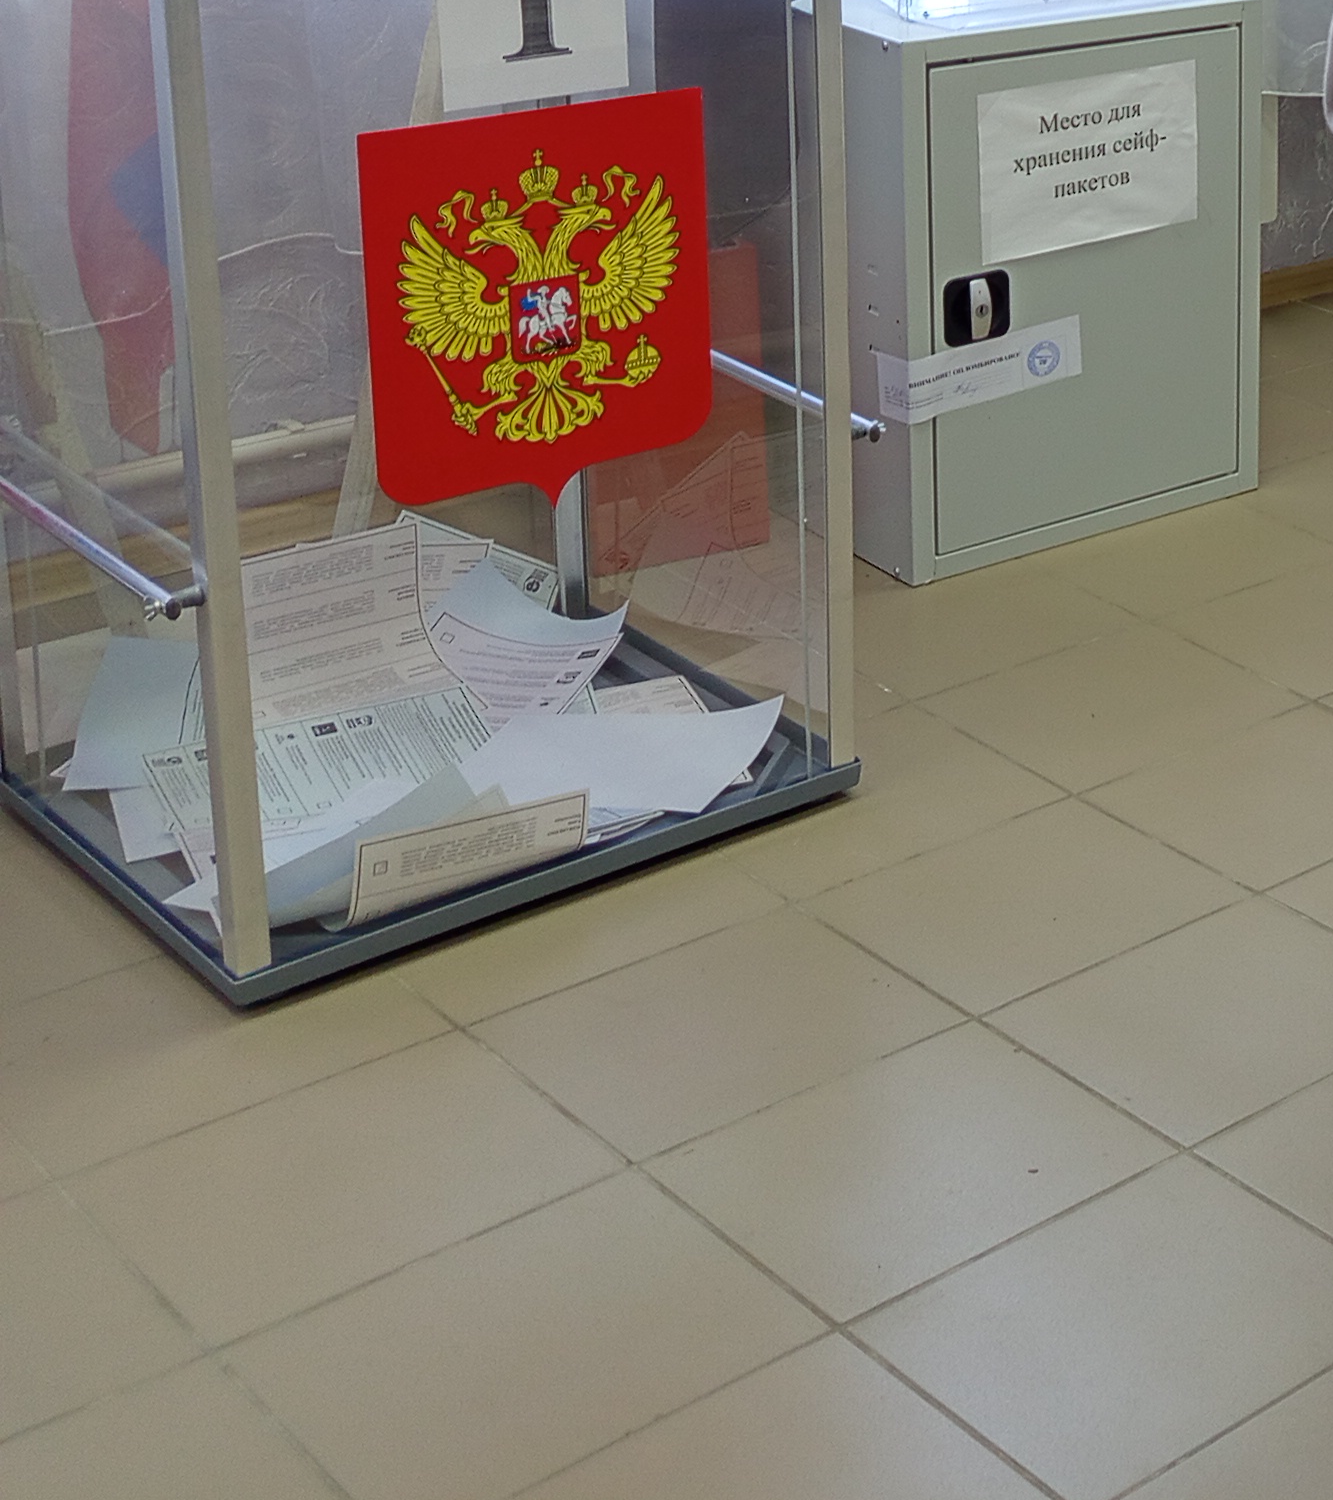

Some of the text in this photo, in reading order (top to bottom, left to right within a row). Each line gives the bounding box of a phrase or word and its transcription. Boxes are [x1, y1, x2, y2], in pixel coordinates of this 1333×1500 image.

[1038, 103, 1141, 134] Место для
[1013, 128, 1167, 175] хранения сейф-
[1053, 171, 1131, 198] пакетов
